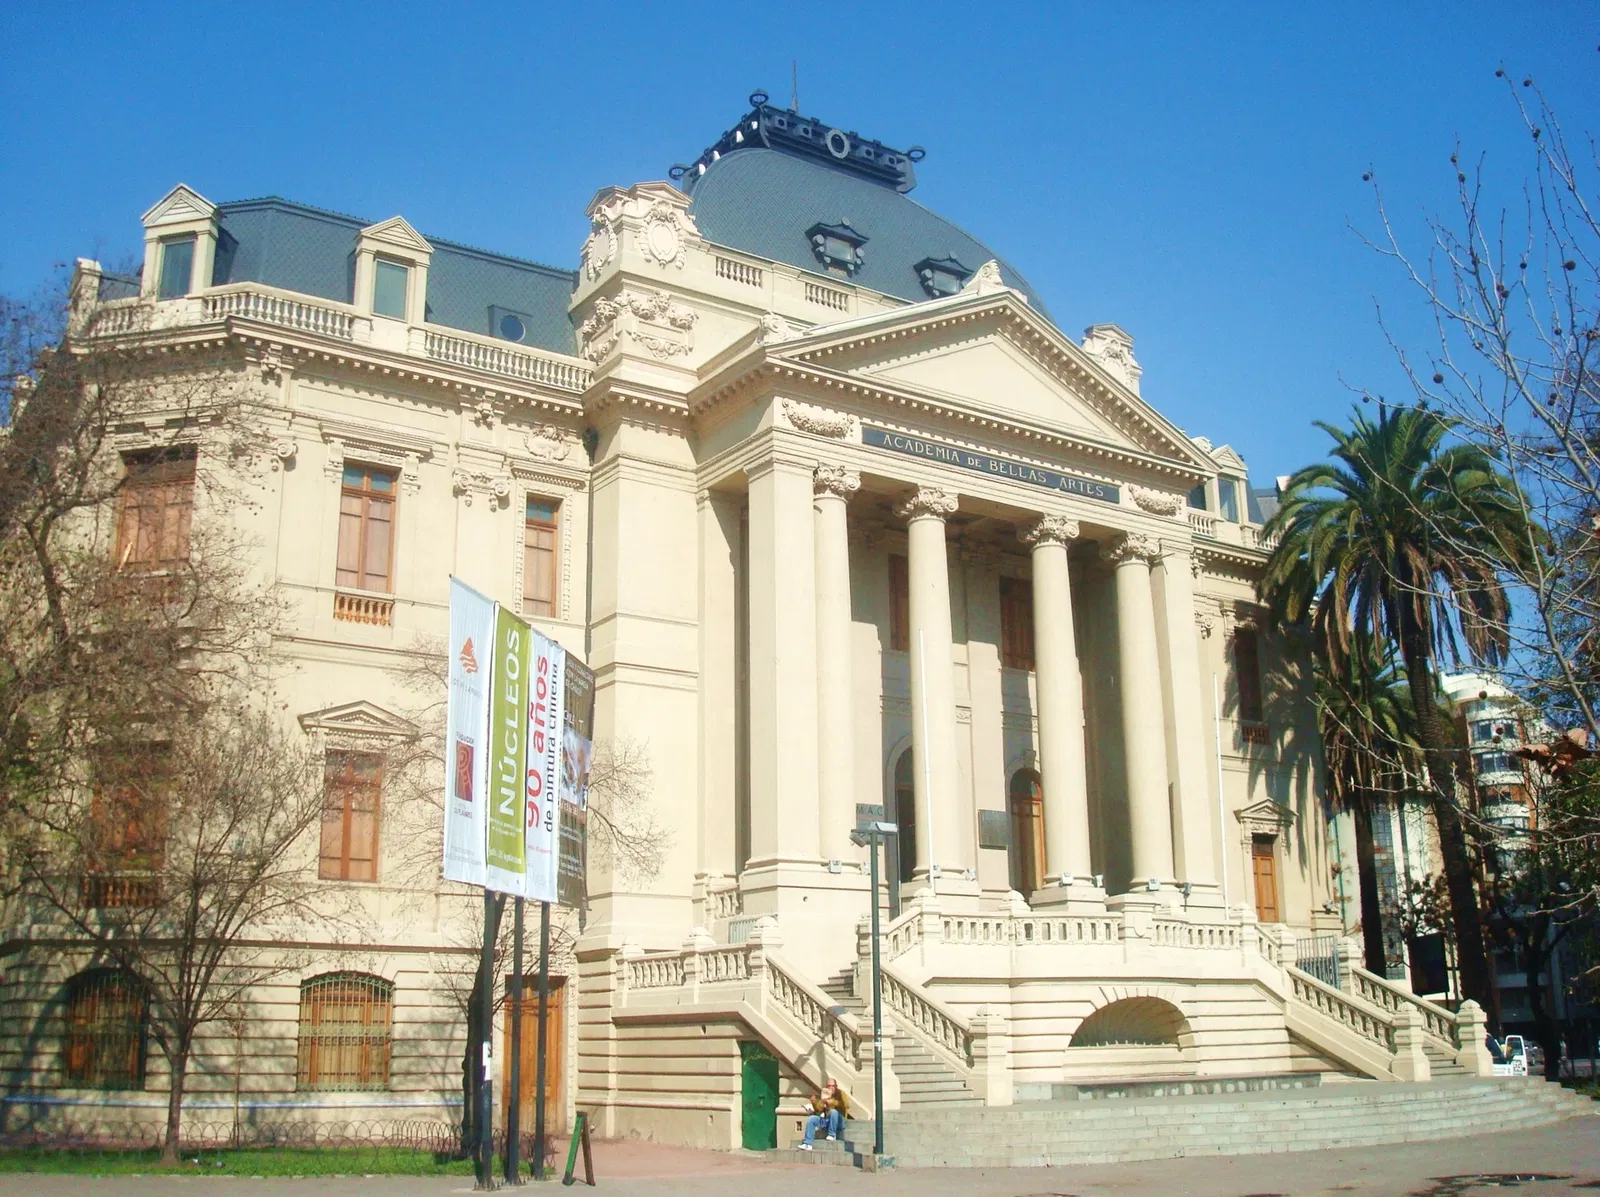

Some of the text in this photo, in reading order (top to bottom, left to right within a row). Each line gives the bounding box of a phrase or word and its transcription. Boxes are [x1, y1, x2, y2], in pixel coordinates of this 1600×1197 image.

[883, 434, 1104, 497] ACADEMIA DE BELLAS ARTES
[498, 627, 520, 816] NÚCLEOS
[530, 655, 548, 754] años
[528, 768, 542, 828] 90
[545, 736, 556, 803] pintura
[544, 810, 554, 833] de
